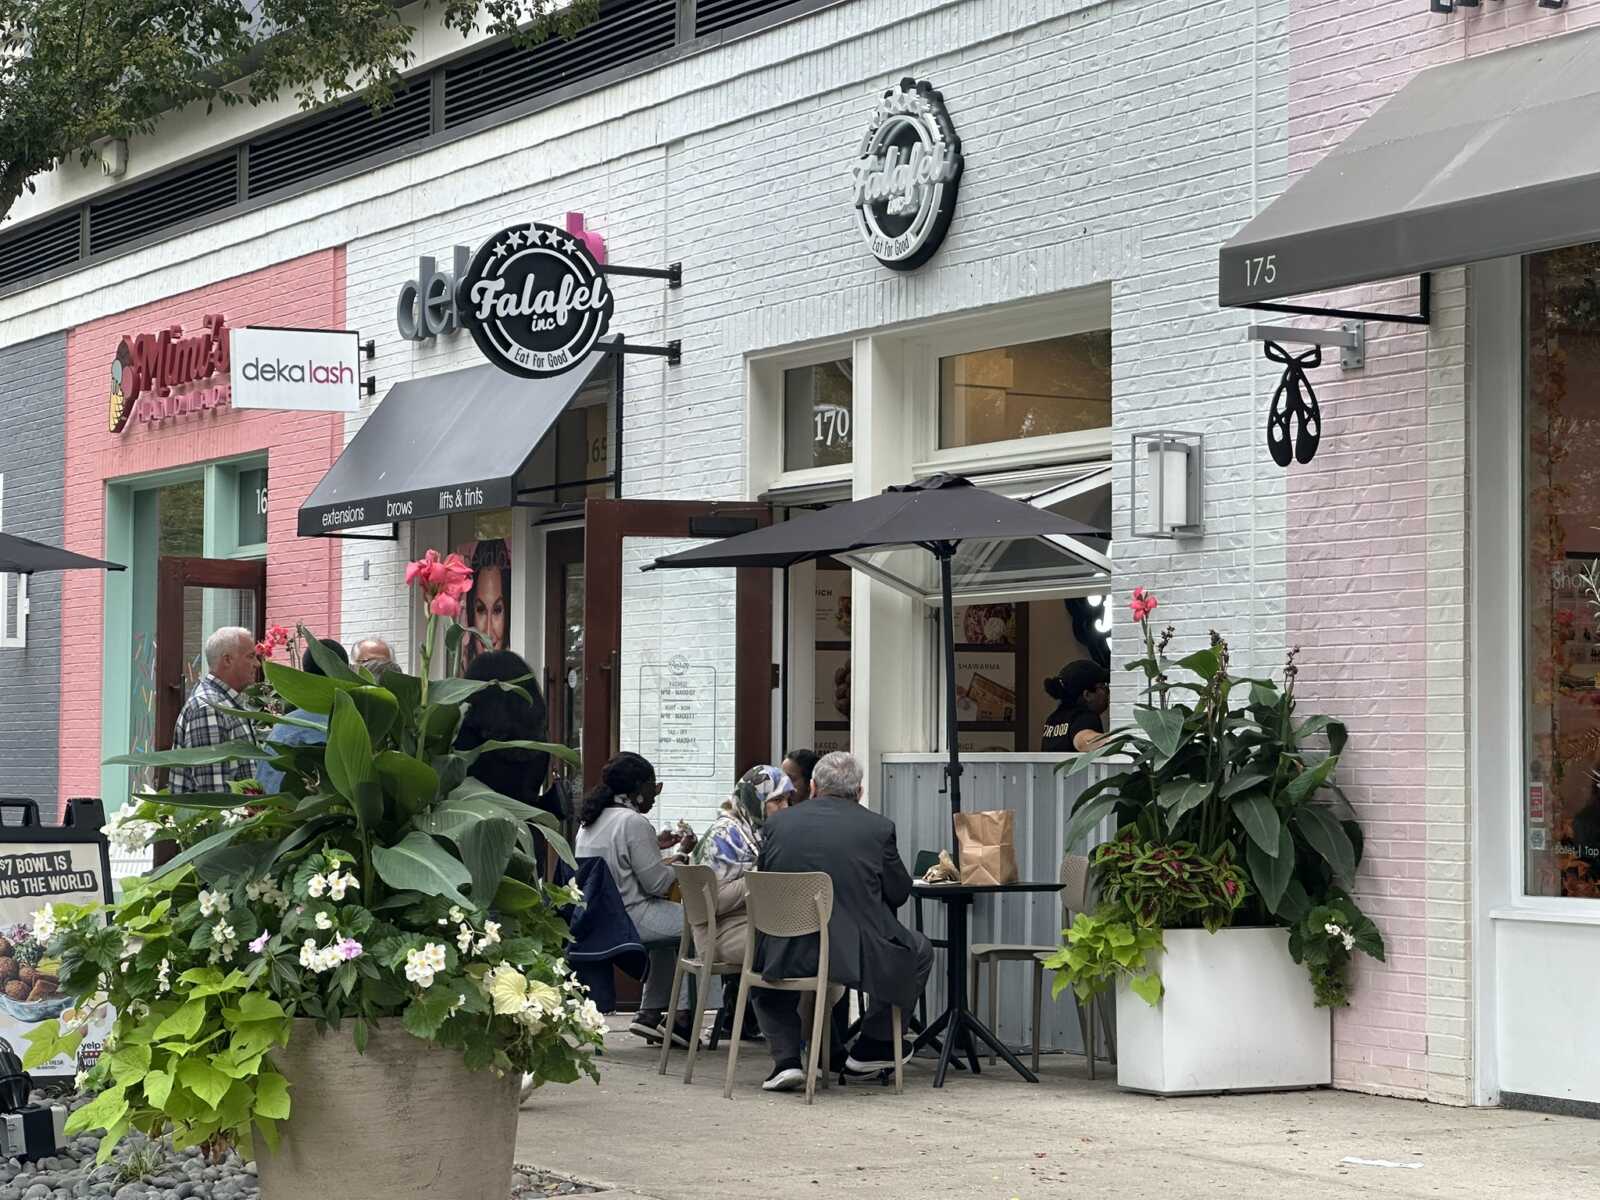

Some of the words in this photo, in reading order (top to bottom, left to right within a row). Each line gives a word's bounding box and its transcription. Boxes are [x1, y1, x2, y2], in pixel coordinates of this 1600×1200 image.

[872, 234, 883, 254] Eat
[894, 232, 910, 256] Good
[1244, 254, 1276, 287] 175
[470, 272, 608, 326] Falafel
[531, 314, 556, 332] inc
[514, 347, 530, 365] Eat
[532, 353, 545, 368] for
[547, 350, 568, 368] Good
[814, 409, 850, 446] 170
[322, 506, 365, 527] extensions
[386, 500, 413, 518] brows
[439, 491, 454, 511] lifts
[455, 489, 463, 507] &
[465, 486, 483, 506] tints
[958, 662, 1001, 671] SHAWARMA
[16, 856, 53, 875] BOWL
[54, 855, 68, 872] IS
[0, 878, 20, 896] NG
[21, 876, 47, 894] THE
[48, 872, 93, 892] WORLD
[81, 1041, 101, 1051] yelp
